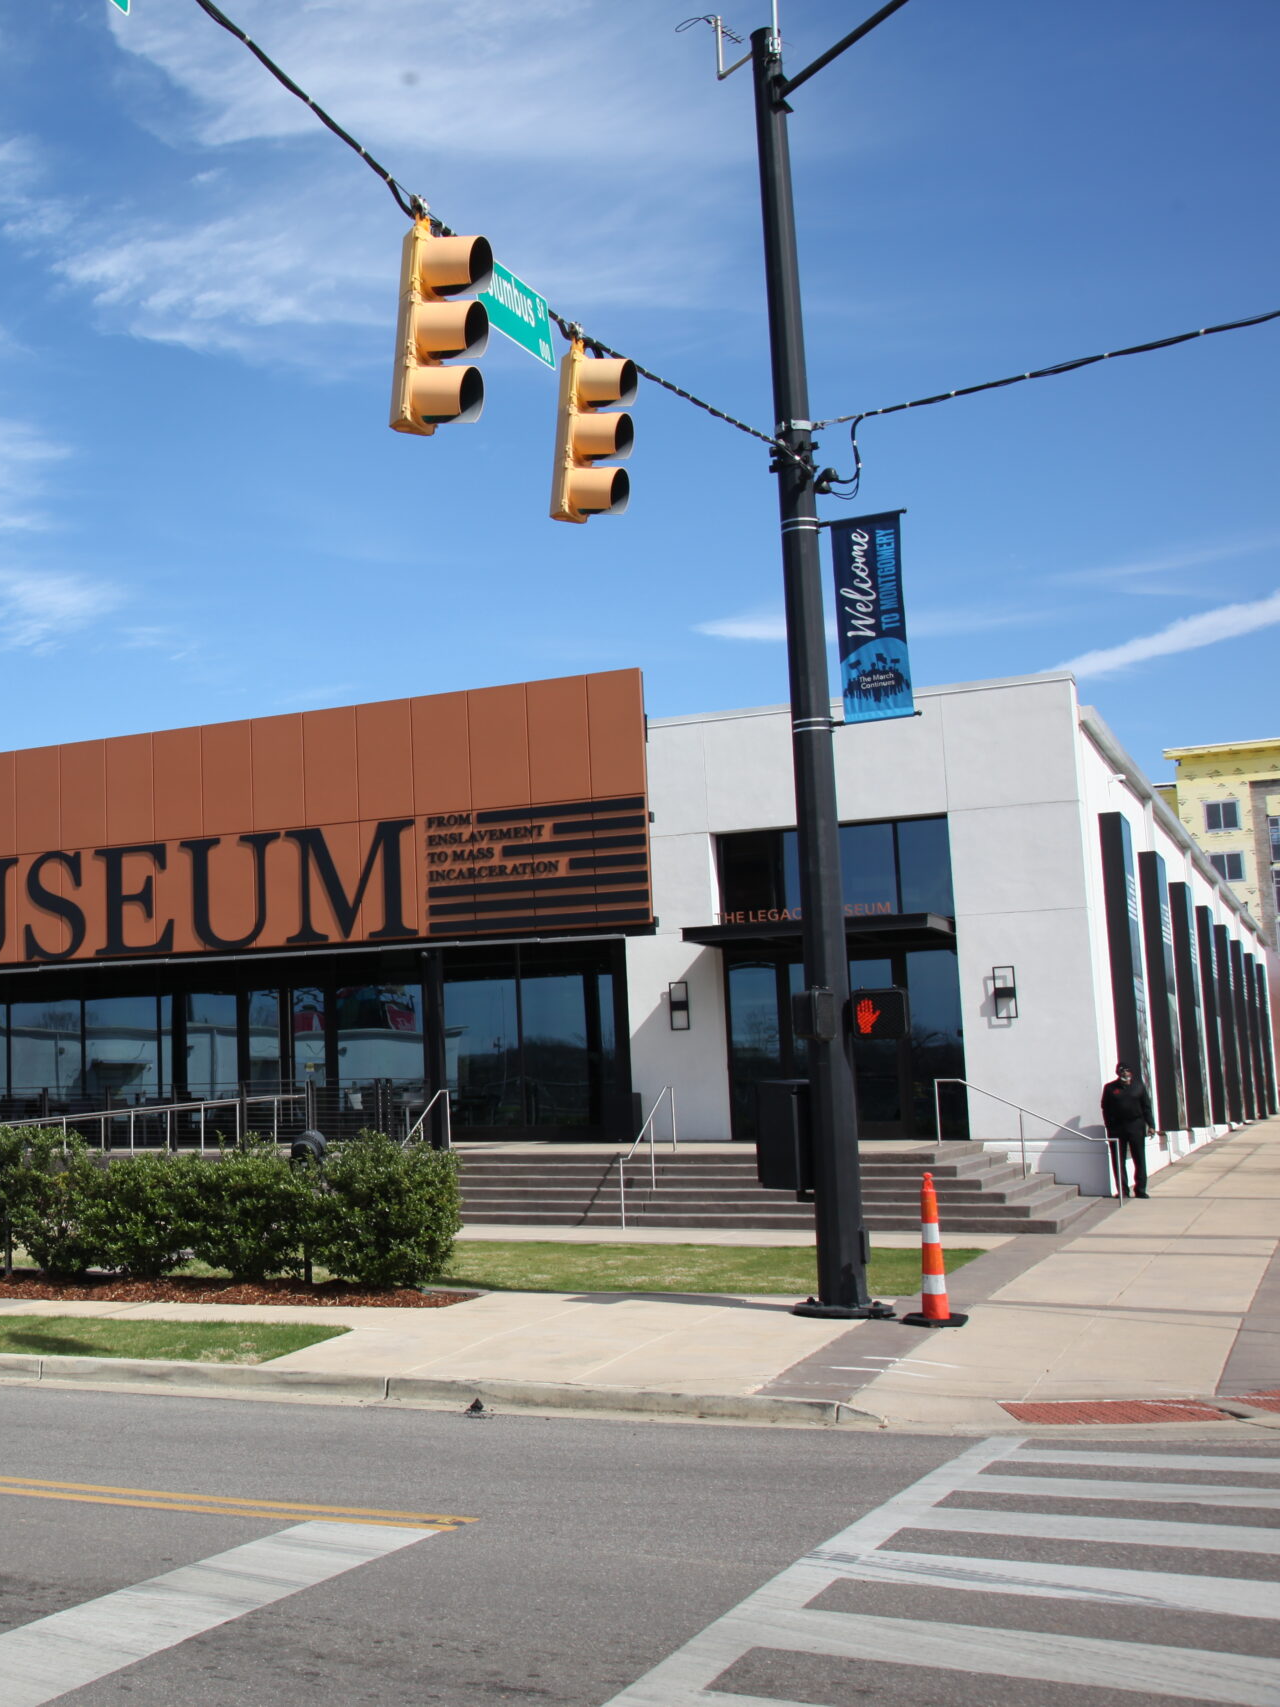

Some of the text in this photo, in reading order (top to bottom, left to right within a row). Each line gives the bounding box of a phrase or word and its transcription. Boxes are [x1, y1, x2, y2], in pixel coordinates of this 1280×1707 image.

[488, 270, 546, 328] lumbus St
[840, 528, 877, 638] Welcome
[875, 528, 901, 631] TO MONTGOMERY
[860, 680, 896, 690] Continues
[872, 671, 895, 681] March
[427, 813, 472, 829] FROM
[427, 824, 545, 847] ENSLAVEMENT
[427, 846, 495, 865] TO MASS
[428, 859, 560, 883] INCARCERATION
[714, 901, 892, 925] THE LEGAC SEUM
